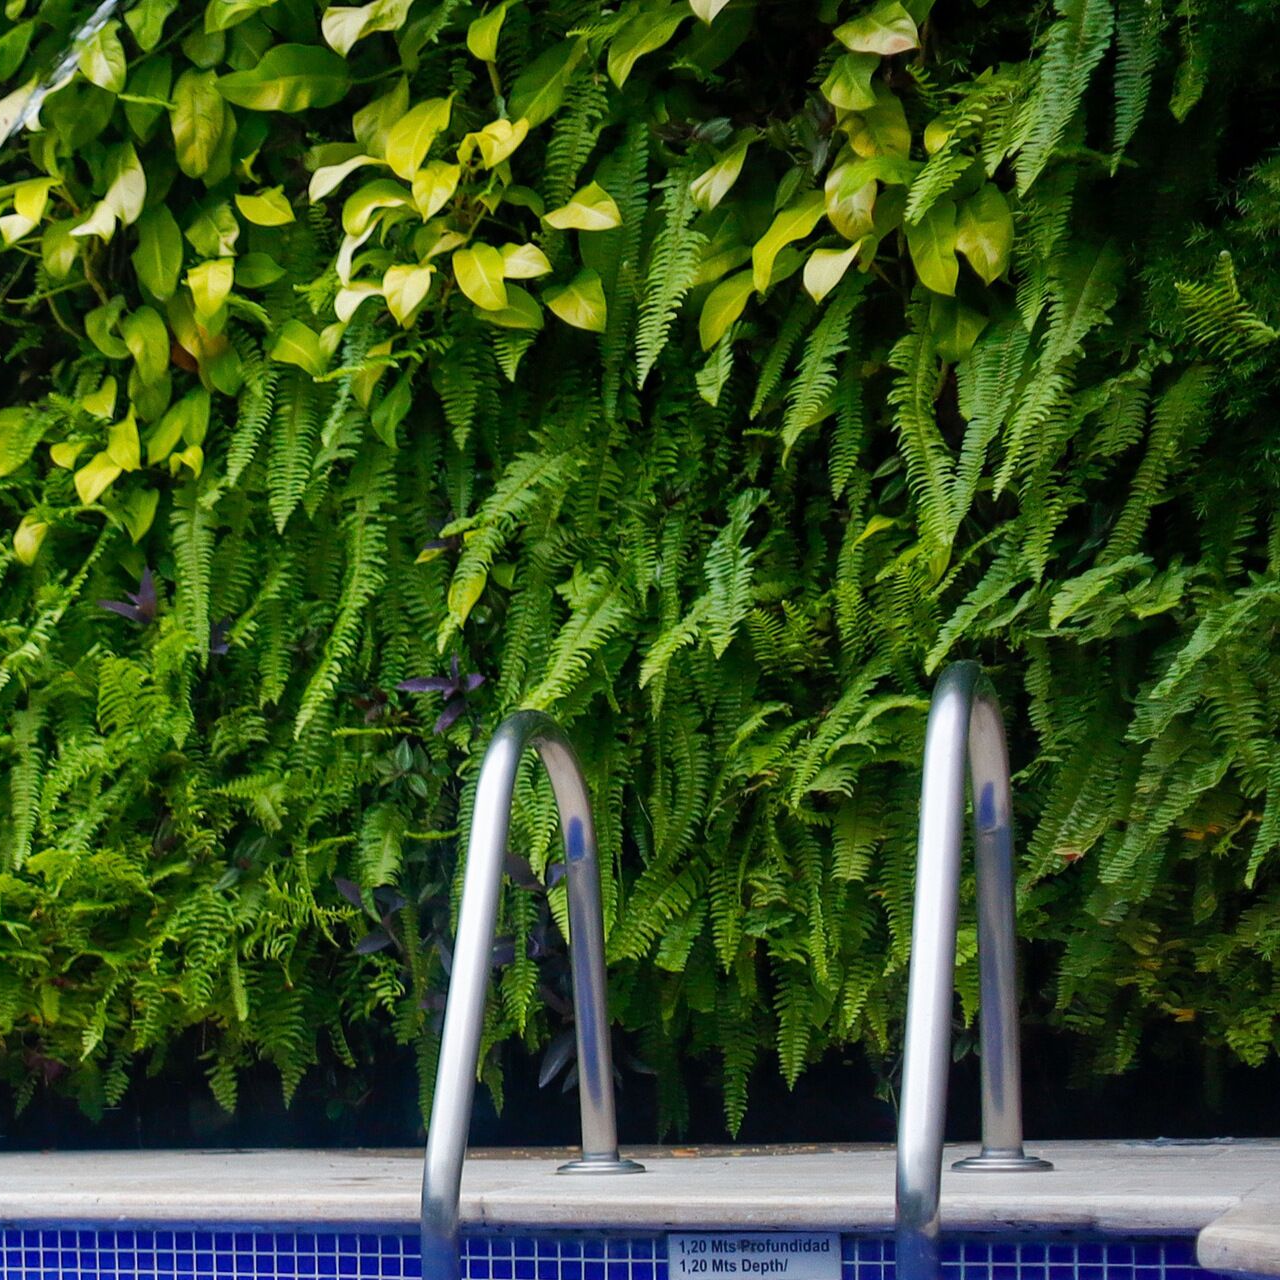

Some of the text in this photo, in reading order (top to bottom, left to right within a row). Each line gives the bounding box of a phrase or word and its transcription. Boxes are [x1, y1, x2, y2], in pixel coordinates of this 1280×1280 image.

[679, 1239, 830, 1254] 1,20 Mts Profundidad
[679, 1260, 707, 1274] 1,20
[712, 1259, 737, 1273] Mts
